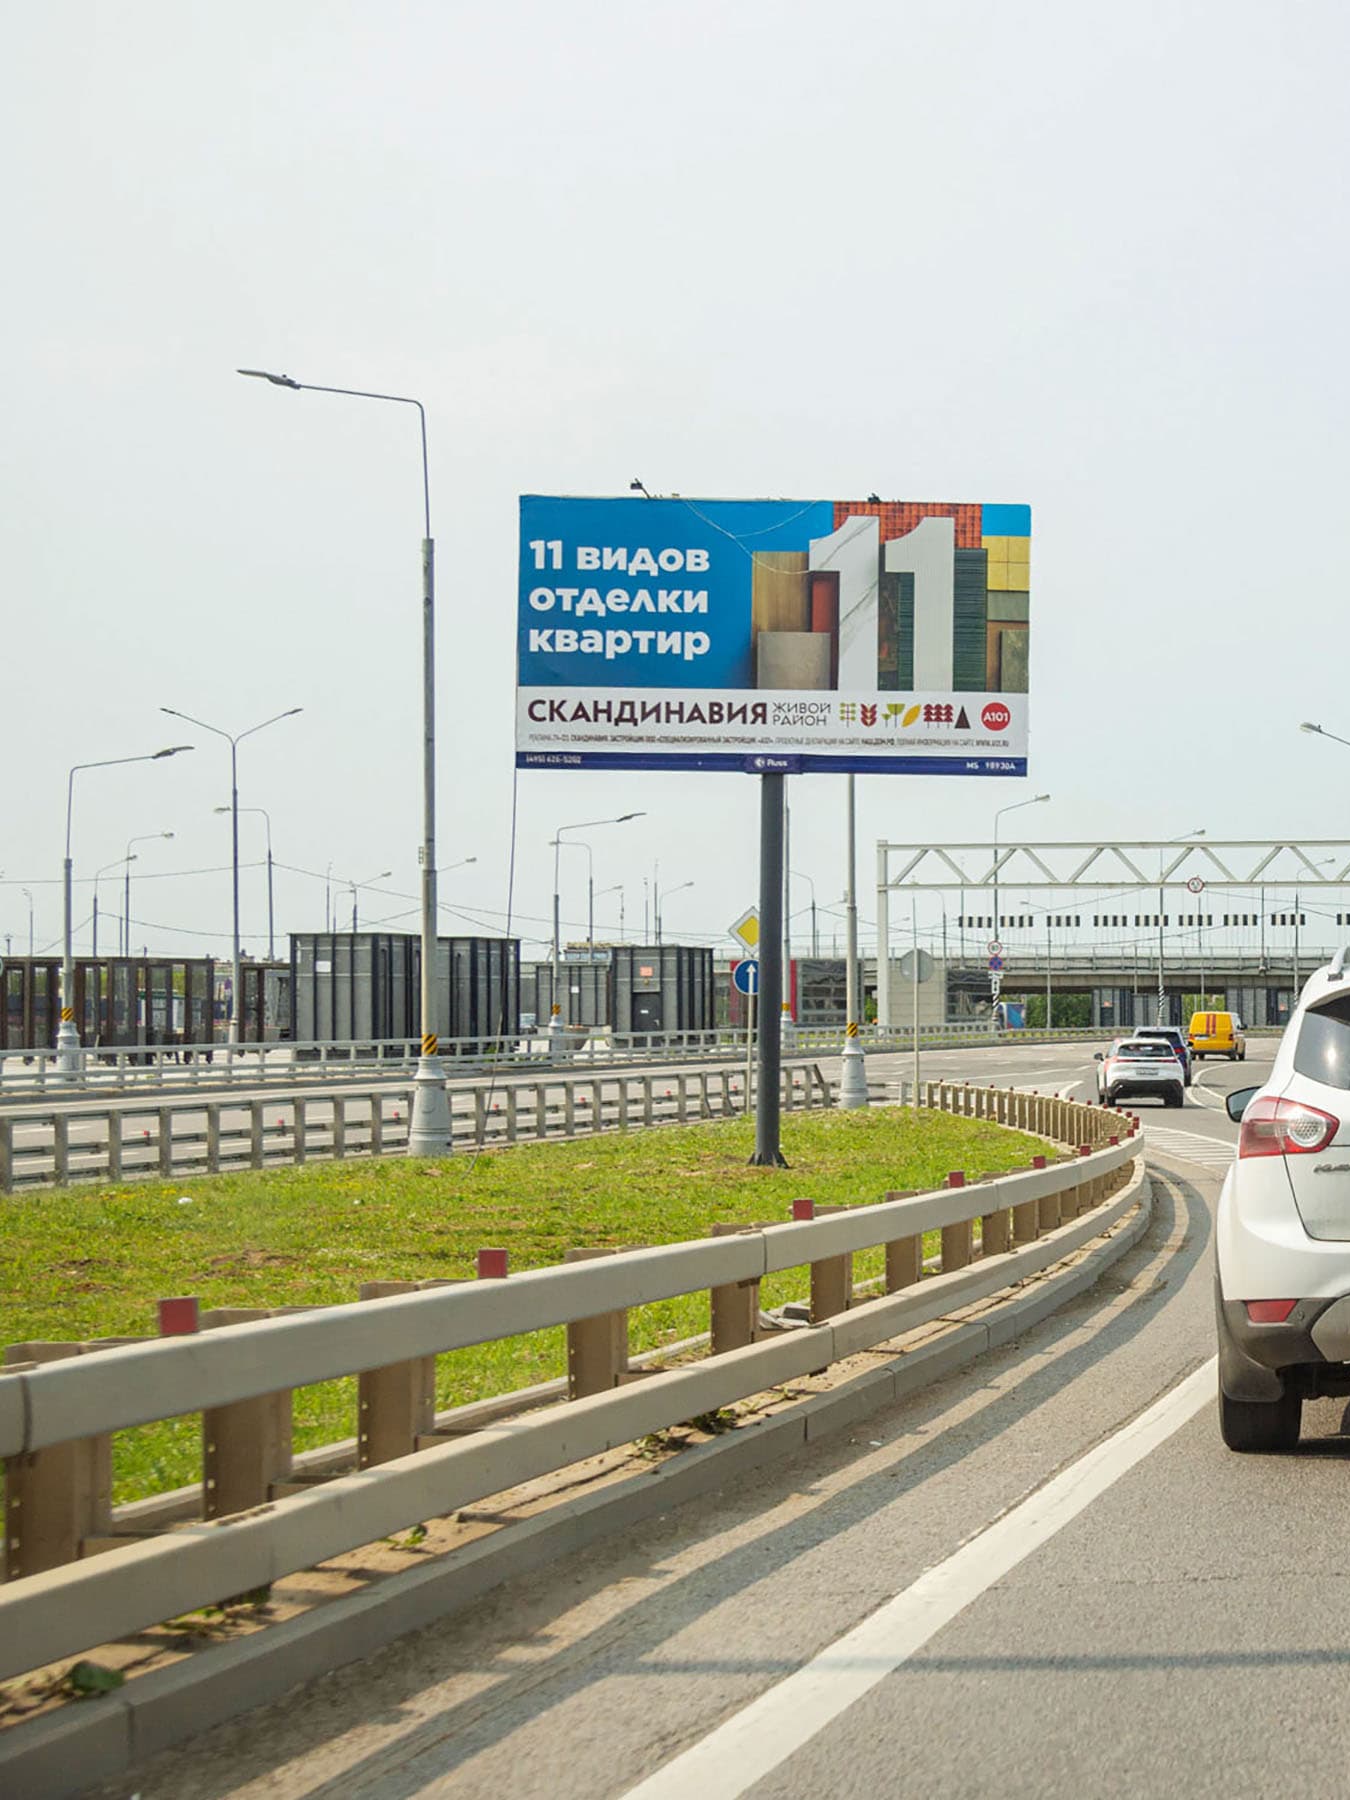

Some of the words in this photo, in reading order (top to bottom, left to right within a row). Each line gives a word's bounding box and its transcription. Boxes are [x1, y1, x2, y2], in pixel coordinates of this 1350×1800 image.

[529, 540, 563, 570] 11
[577, 546, 710, 577] видов
[529, 587, 709, 617] отделки
[529, 629, 711, 661] квартир
[527, 699, 768, 727] СКАНДИНАВИЯ
[772, 701, 831, 714] ЖИВОЙ
[772, 712, 828, 727] РАЙОН
